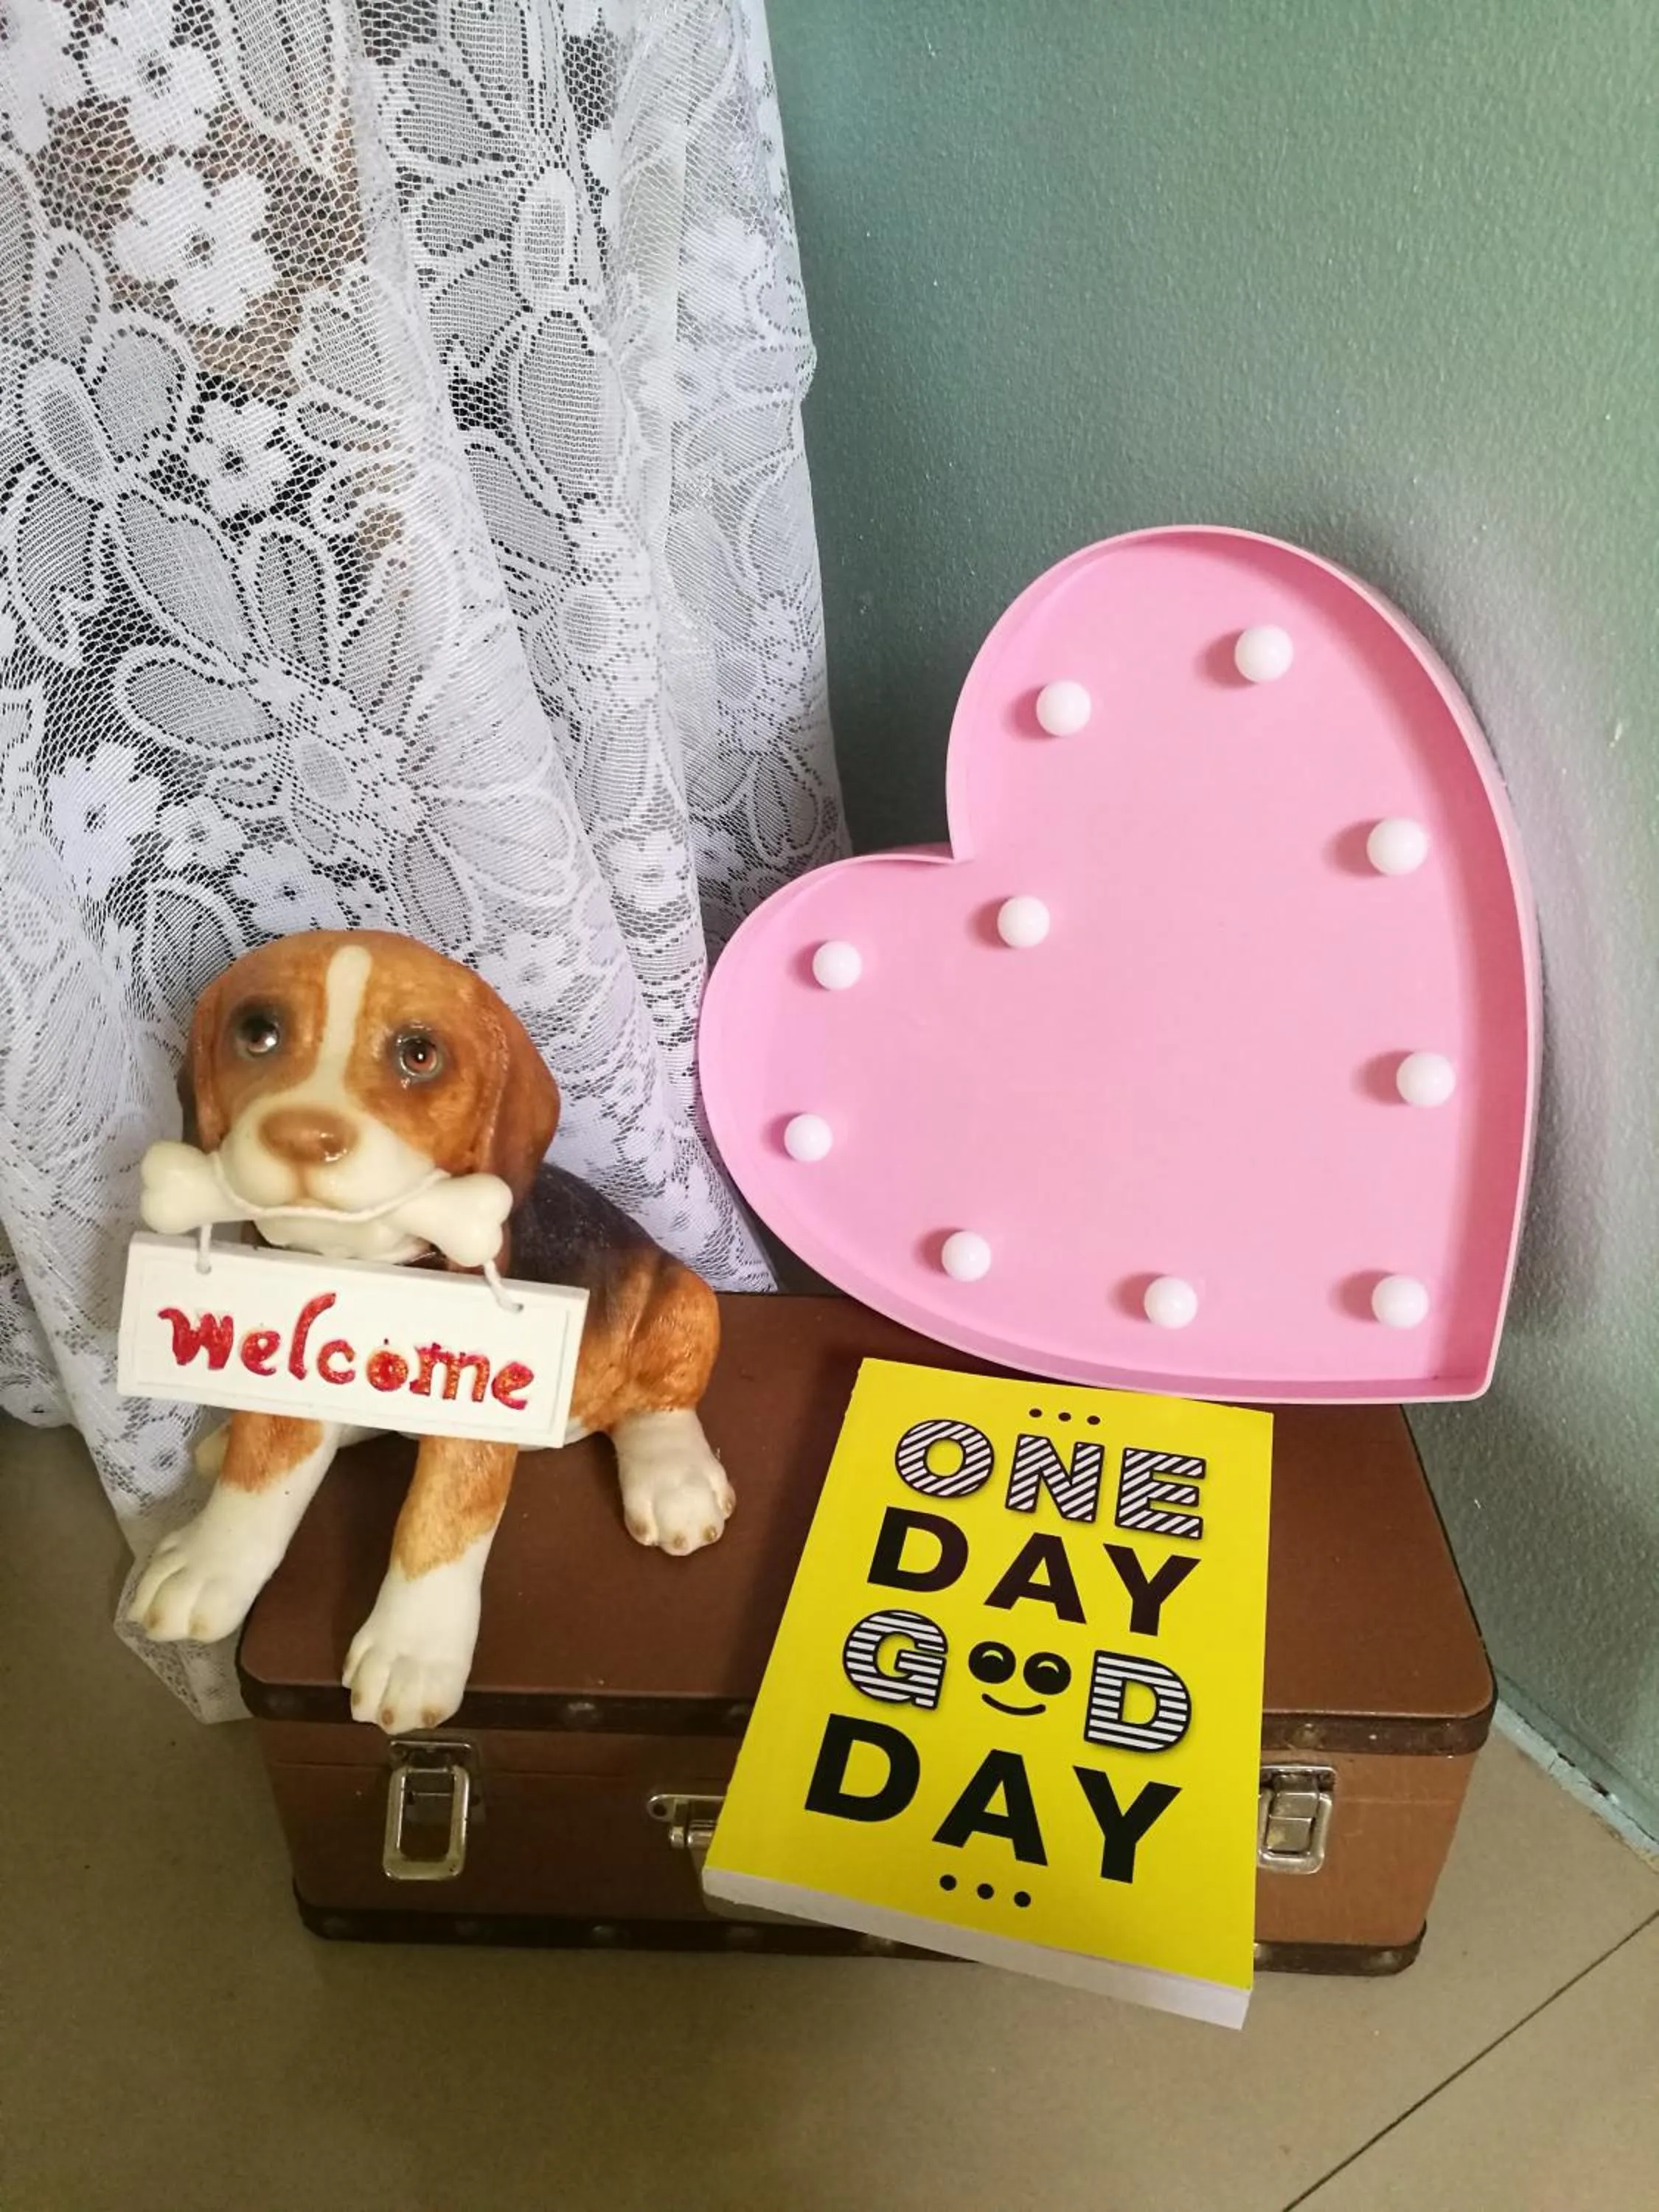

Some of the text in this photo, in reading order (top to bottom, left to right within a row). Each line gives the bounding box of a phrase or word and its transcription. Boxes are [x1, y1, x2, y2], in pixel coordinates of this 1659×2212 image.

[894, 1419, 1206, 1540] ONE
[866, 1506, 1201, 1637] DAY
[804, 1713, 1182, 1884] DAY
